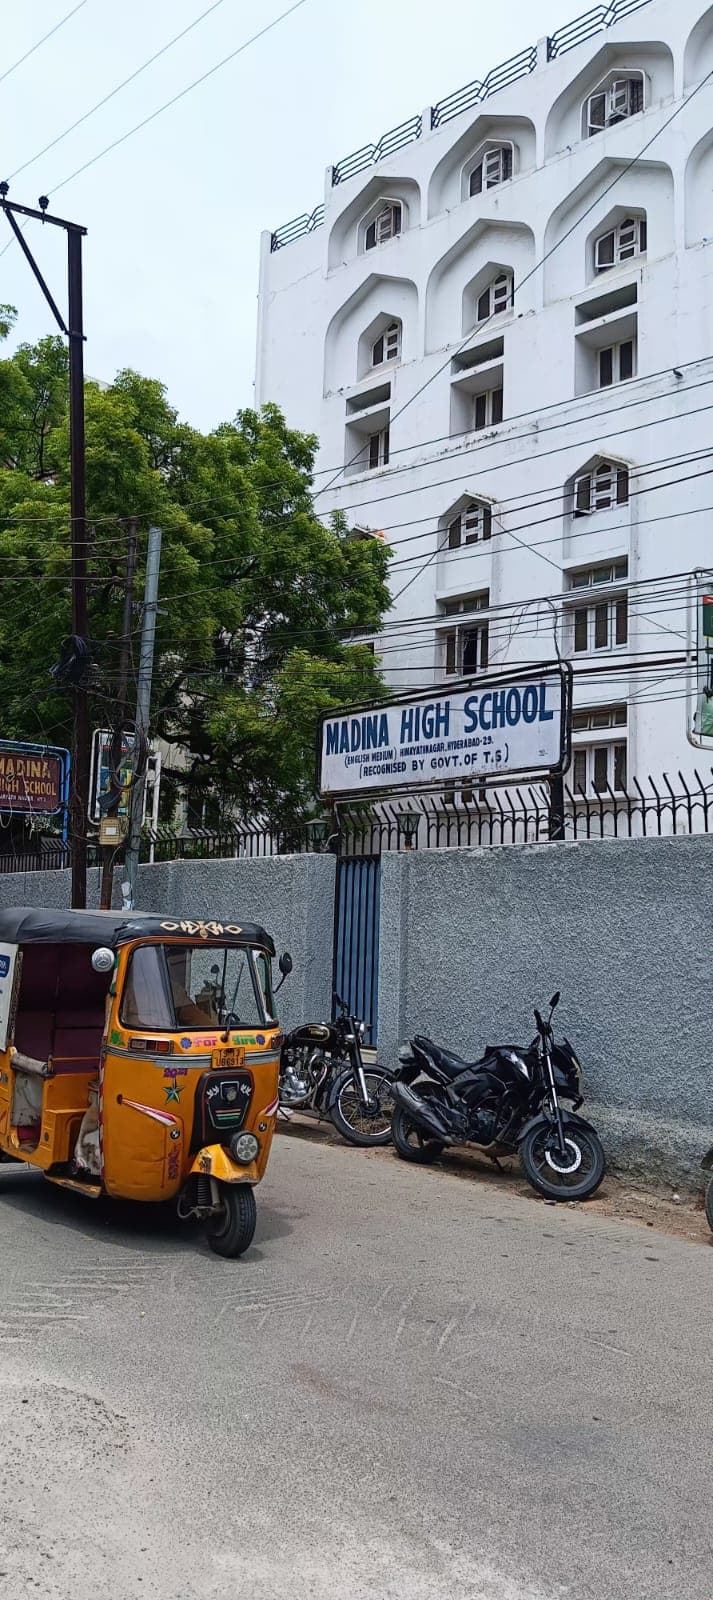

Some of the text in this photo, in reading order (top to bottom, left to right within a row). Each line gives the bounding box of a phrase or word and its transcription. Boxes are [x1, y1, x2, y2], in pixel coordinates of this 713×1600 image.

[325, 682, 554, 756] MADINA HIGH SCHOOL
[344, 753, 370, 768] (ENGLISH
[371, 746, 397, 762] MEDIUM)
[359, 761, 407, 779] (RECOGNISED
[412, 759, 425, 771] BY
[24, 780, 57, 796] SCHOOL
